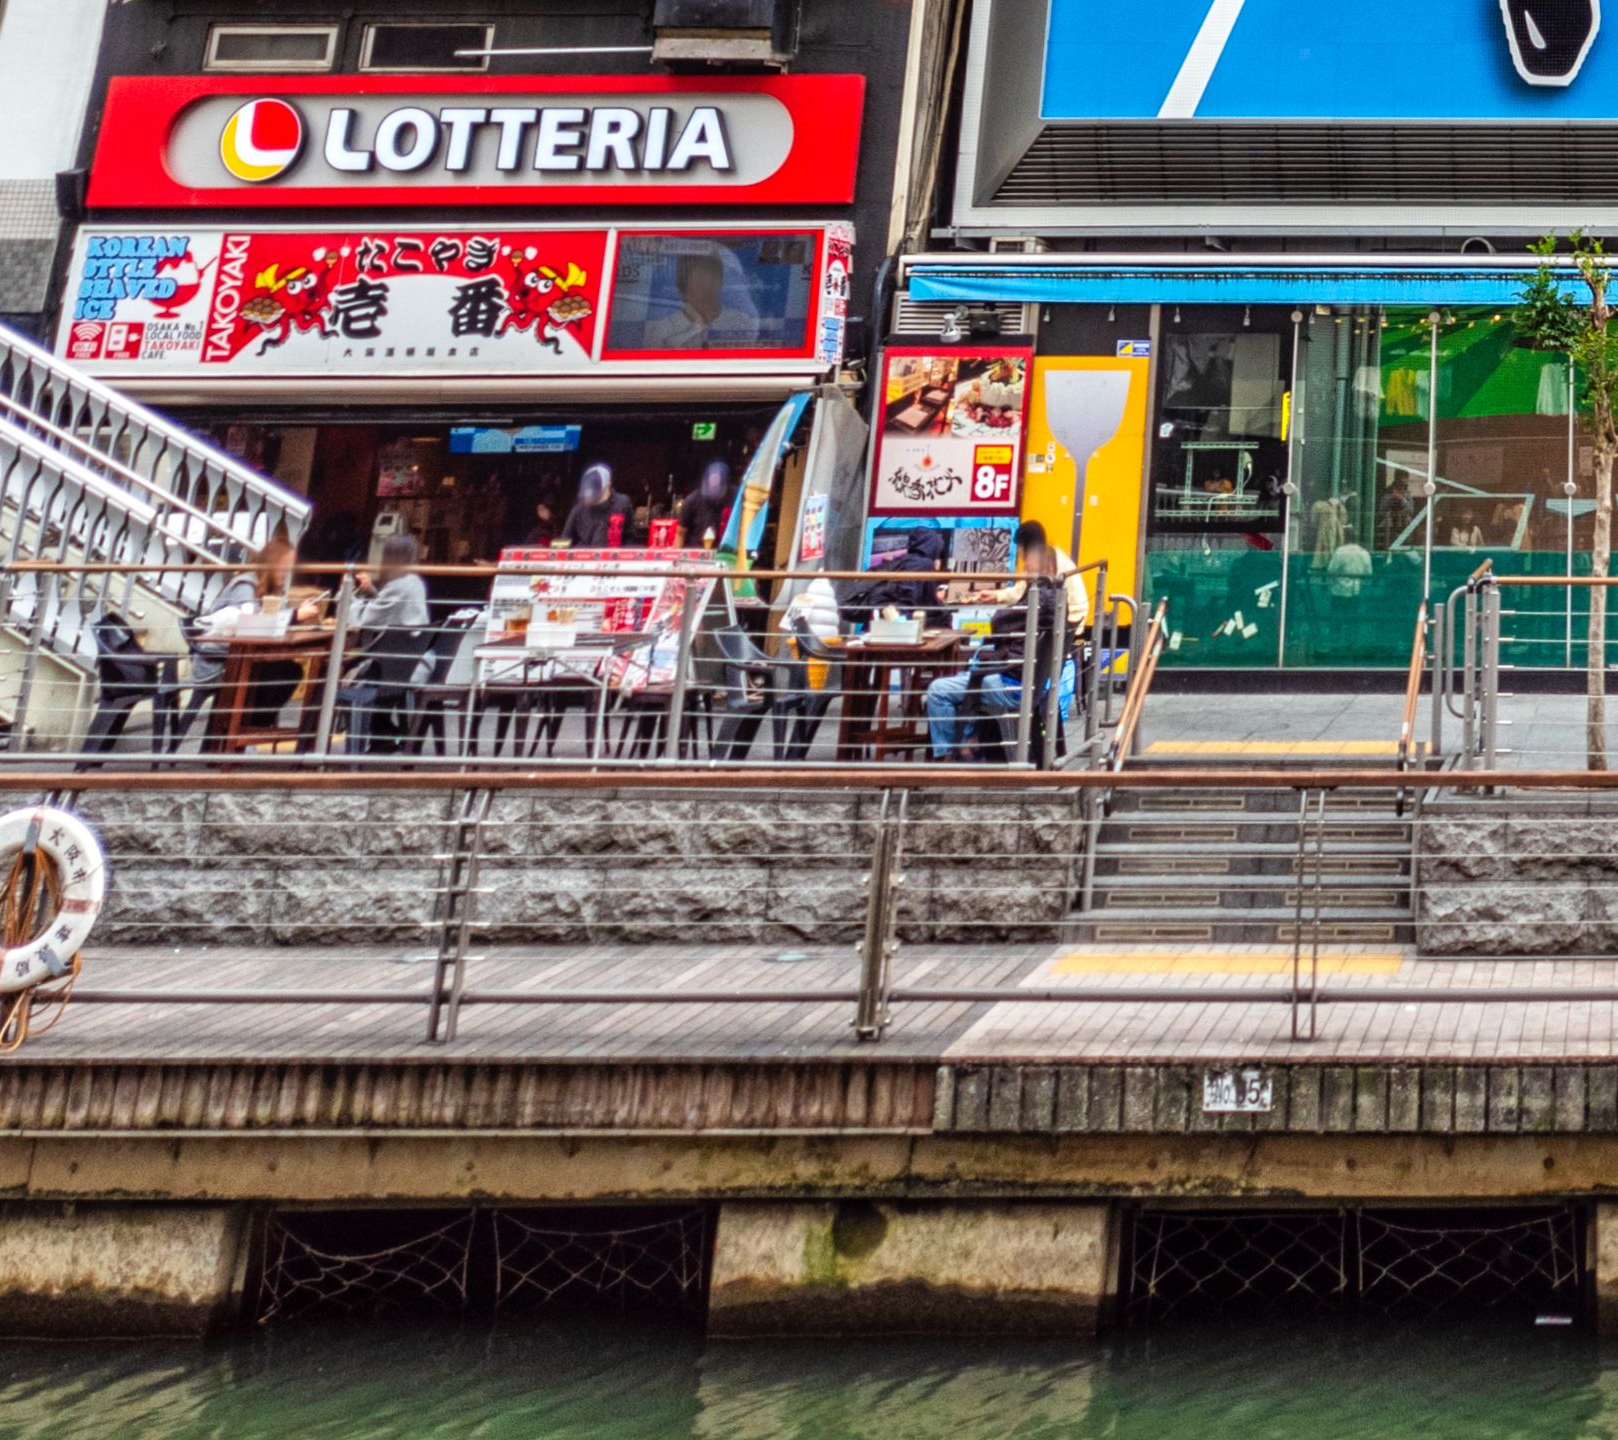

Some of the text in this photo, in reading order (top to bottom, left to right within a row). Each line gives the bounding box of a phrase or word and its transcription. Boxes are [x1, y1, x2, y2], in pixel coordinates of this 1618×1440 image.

[323, 105, 733, 173] LOTTERIA
[86, 236, 190, 259] KOREAN
[354, 234, 500, 272] たこやき
[82, 257, 159, 278] STYLE
[77, 277, 178, 300] SHAVED
[206, 235, 251, 362] TAKOYAKI
[73, 299, 117, 320] ICE
[329, 275, 509, 339] 壱番
[145, 331, 201, 340] LOCAL FOOD
[146, 323, 180, 331] OSAKA
[145, 340, 200, 350] TAKOYAKI
[974, 466, 1010, 499] 8F
